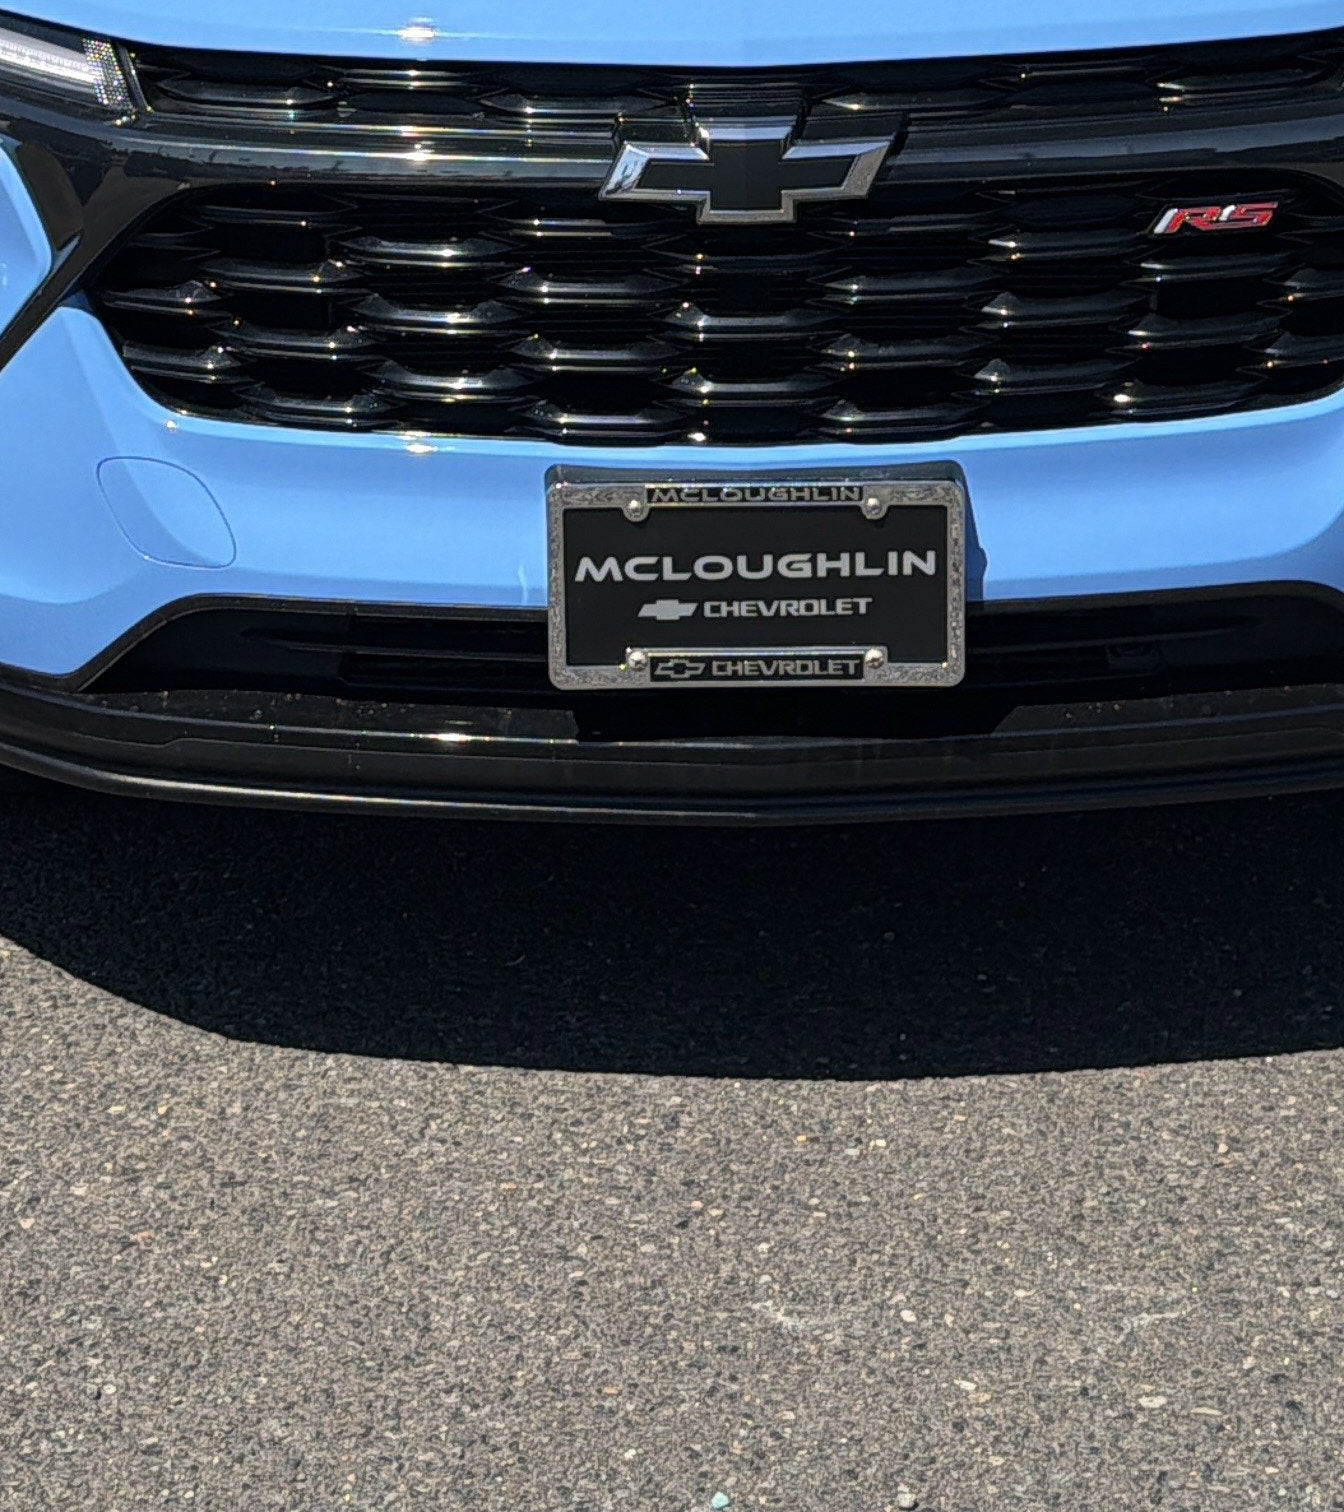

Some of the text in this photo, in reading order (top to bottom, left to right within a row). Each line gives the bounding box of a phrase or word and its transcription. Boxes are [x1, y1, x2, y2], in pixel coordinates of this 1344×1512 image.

[1154, 201, 1278, 234] RS
[652, 486, 860, 503] MCLOUGHLIN
[574, 550, 937, 582] MCLOUGHLIN
[703, 597, 873, 618] CHEVROLET
[711, 658, 860, 677] CHEVROLET
